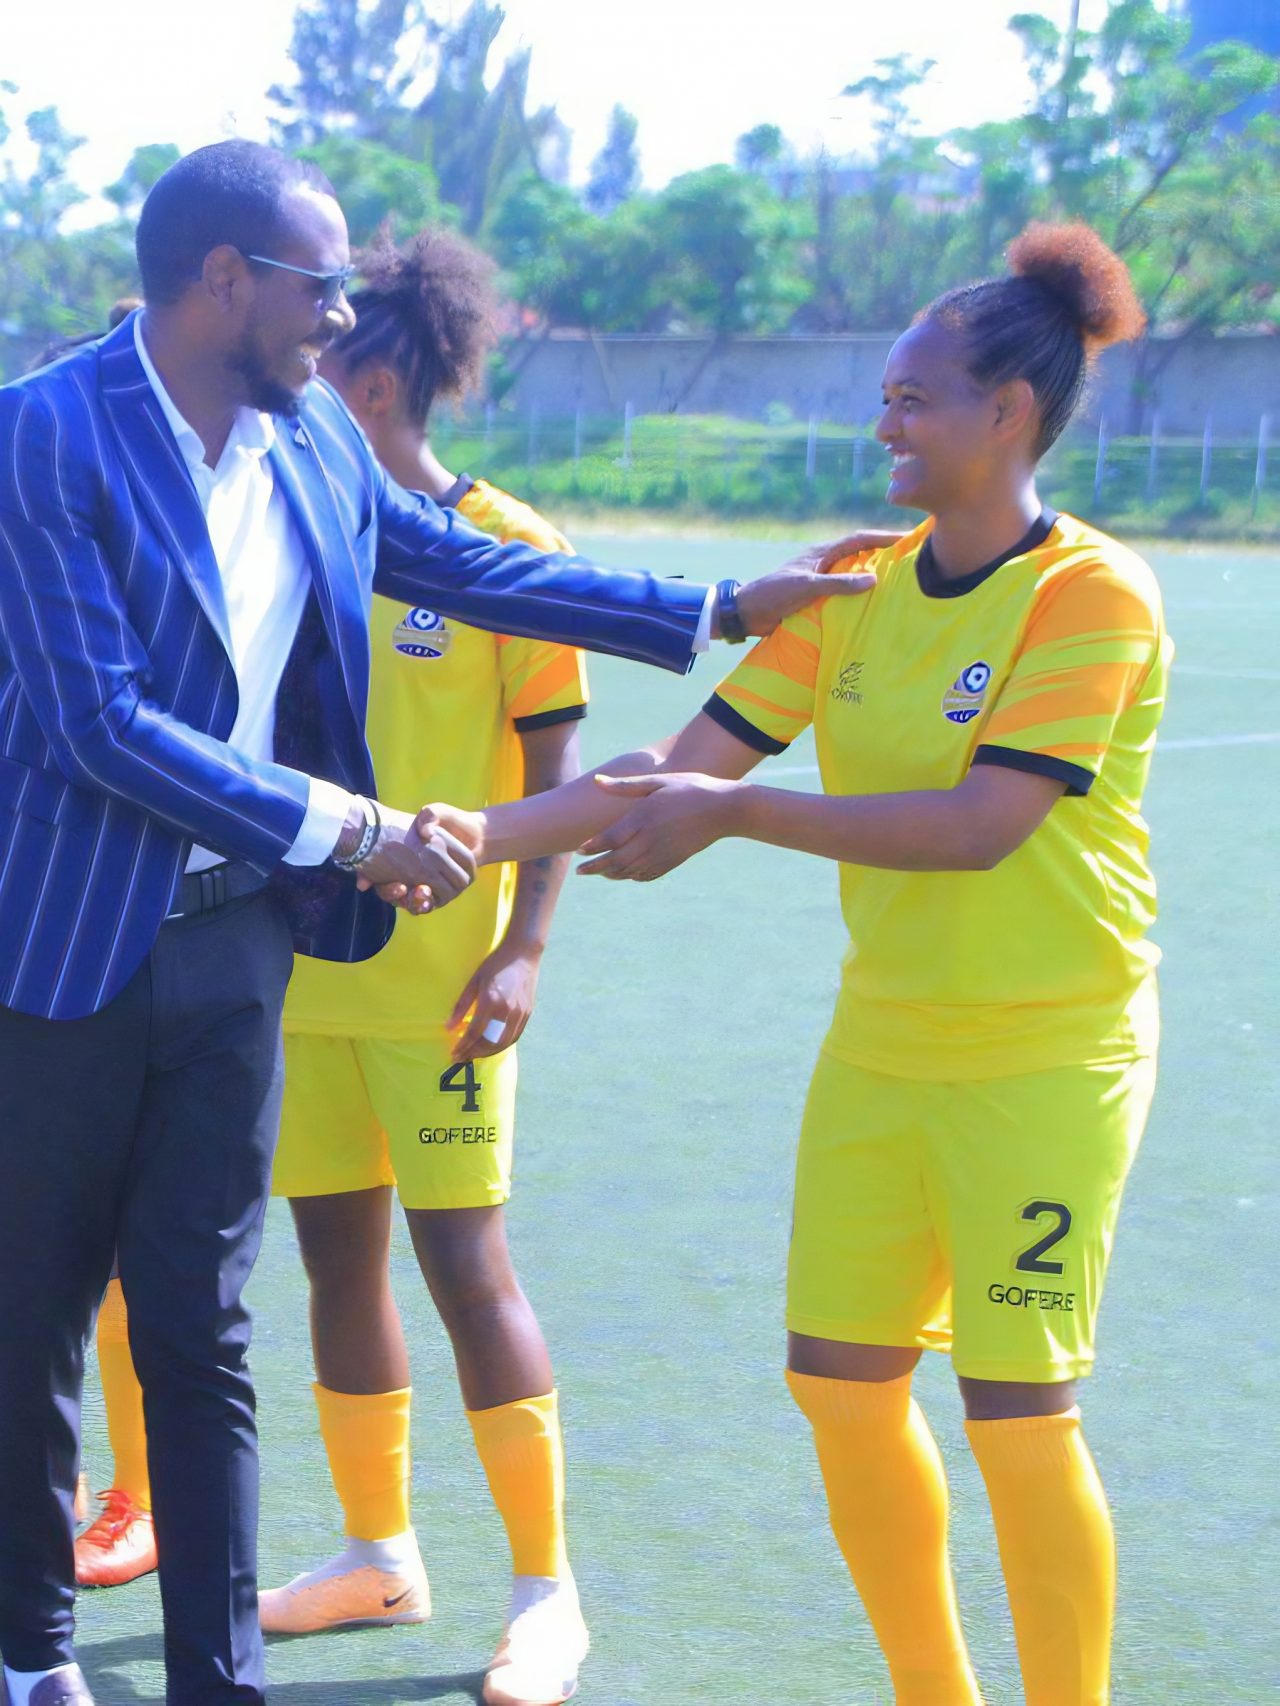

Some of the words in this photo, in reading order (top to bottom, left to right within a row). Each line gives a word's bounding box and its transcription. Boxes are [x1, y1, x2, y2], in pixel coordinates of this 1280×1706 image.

[439, 1060, 482, 1112] 4
[419, 1127, 496, 1144] GOFERE
[1015, 1200, 1072, 1275] 2
[988, 1283, 1075, 1312] GOFERE
